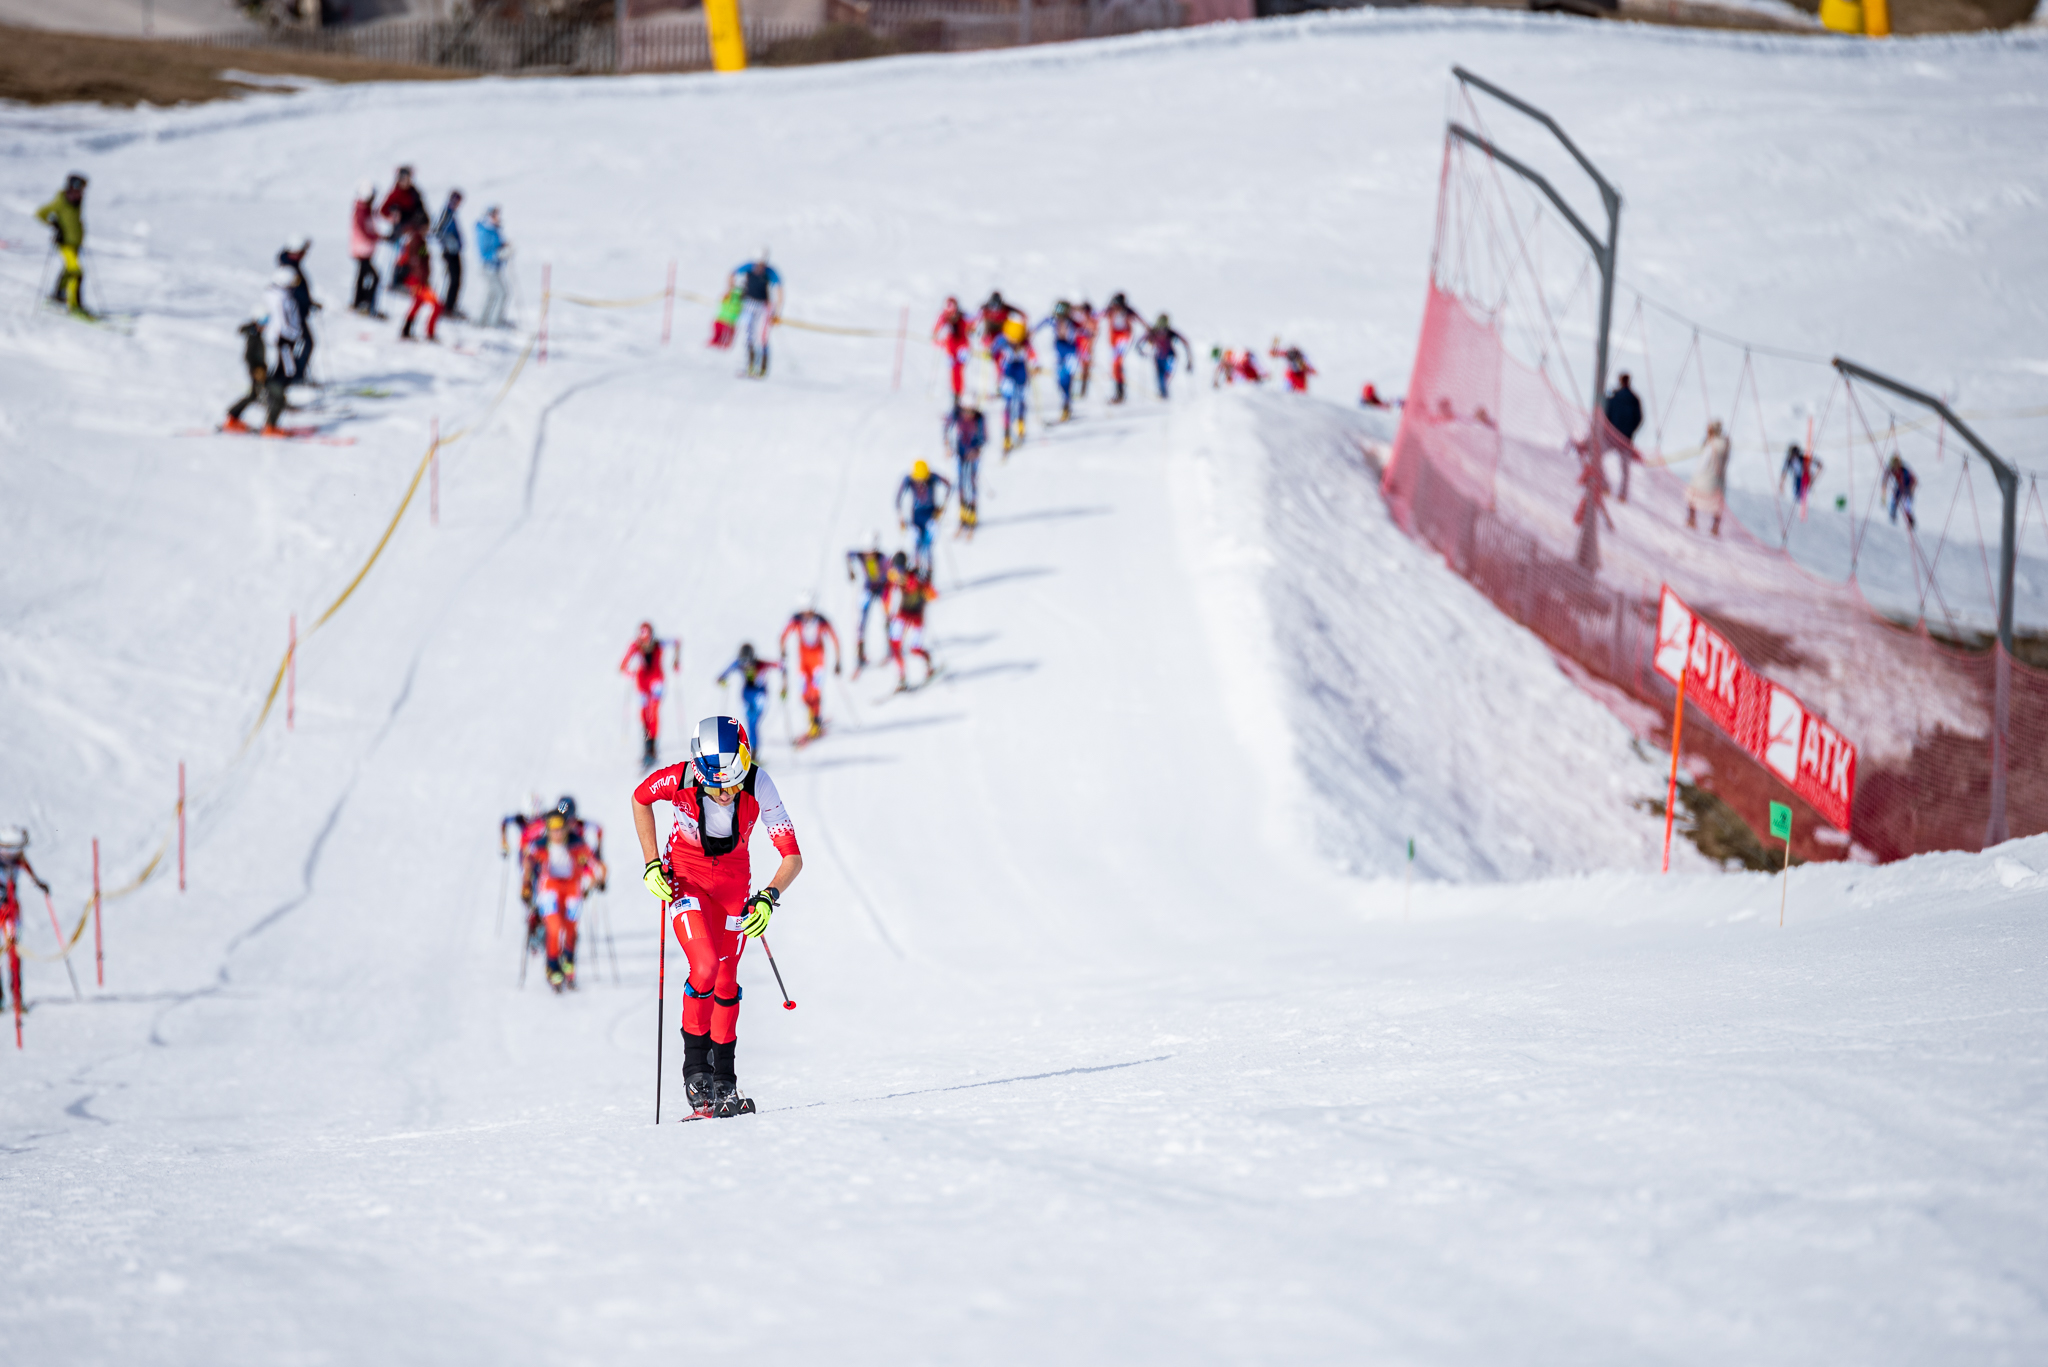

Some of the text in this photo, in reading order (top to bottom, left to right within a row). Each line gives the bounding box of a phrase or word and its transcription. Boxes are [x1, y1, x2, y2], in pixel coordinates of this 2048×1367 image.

[1690, 624, 1738, 708] ATK
[1801, 718, 1851, 803] ATK
[680, 912, 693, 939] 1
[735, 931, 744, 955] 1
